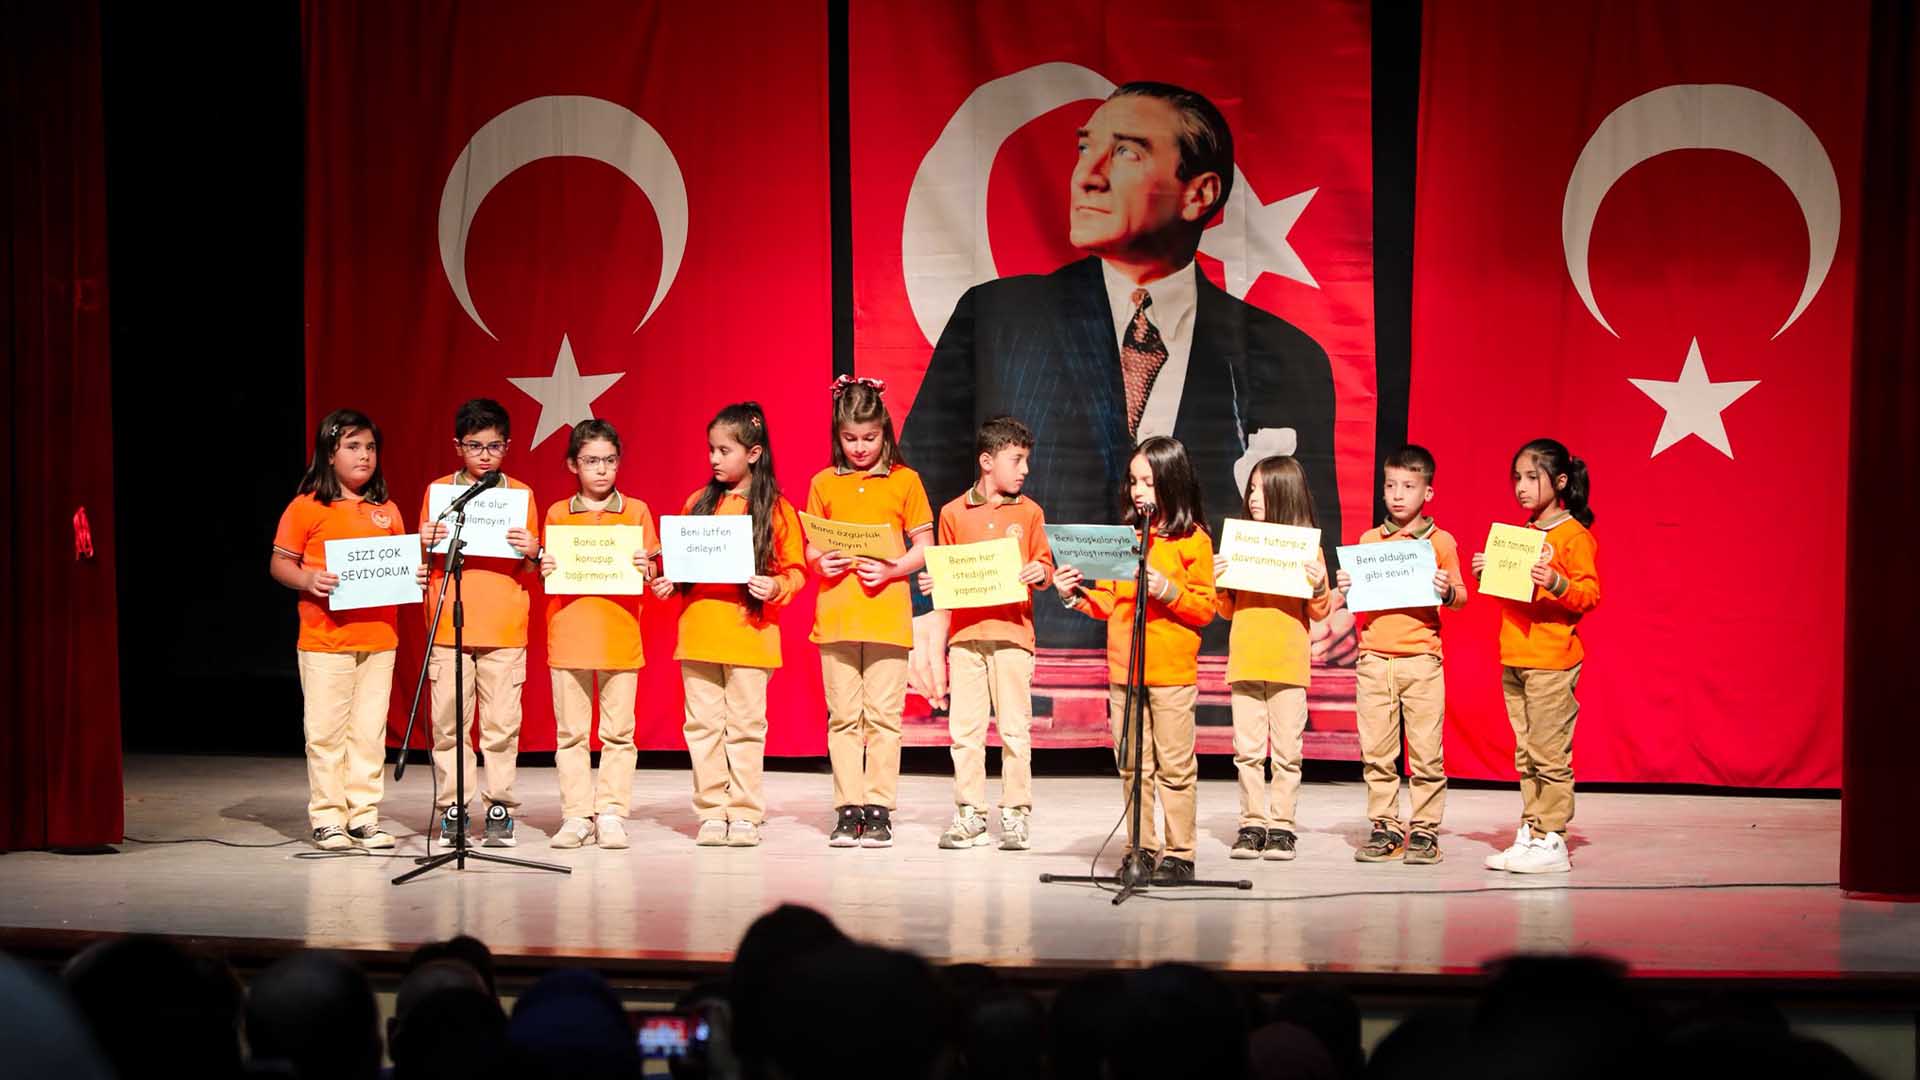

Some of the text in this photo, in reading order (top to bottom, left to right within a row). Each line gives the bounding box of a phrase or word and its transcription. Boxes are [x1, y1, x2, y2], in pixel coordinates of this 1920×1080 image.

[474, 499, 486, 508] ne
[488, 499, 509, 509] olur
[680, 527, 700, 537] Beni
[810, 521, 834, 535] Bana
[573, 536, 597, 547] Bana
[1053, 532, 1074, 543] Beni
[378, 547, 401, 561] ÇOK
[686, 543, 722, 556] dinleyin
[948, 552, 996, 566] Benim her
[1356, 551, 1419, 566] Beni olduğum
[1365, 568, 1383, 583] gibi
[1385, 567, 1410, 579] sevin
